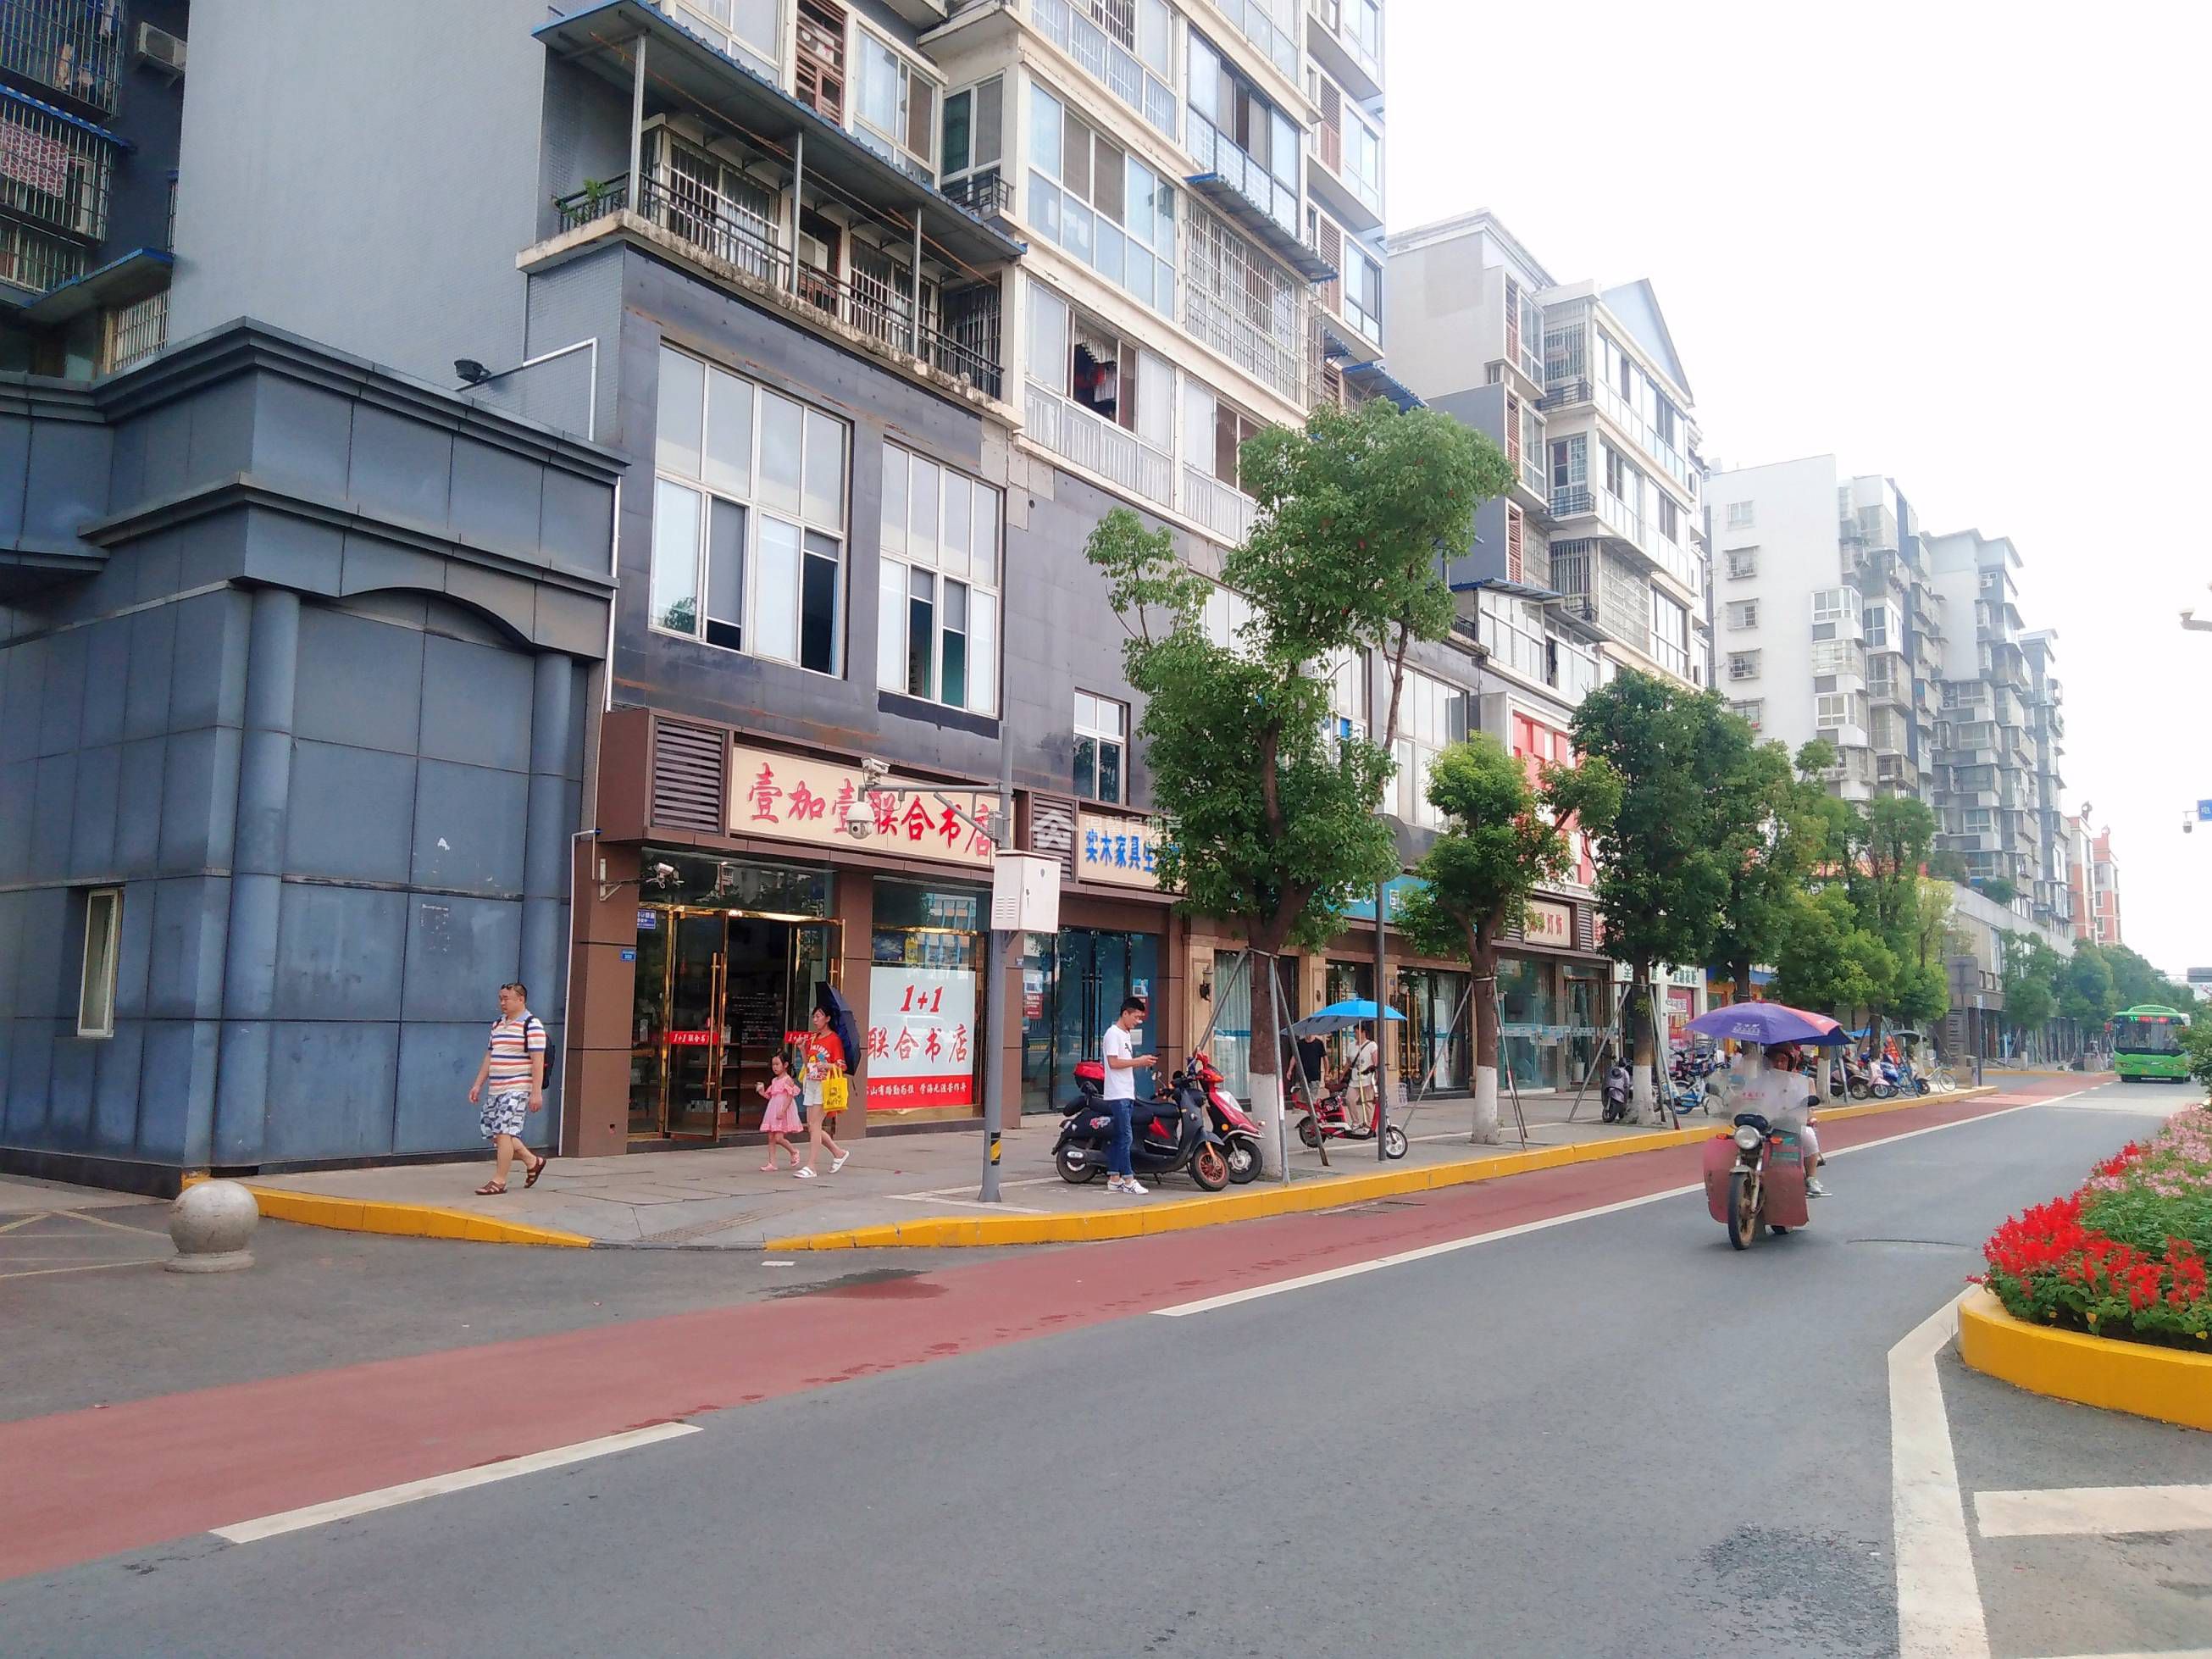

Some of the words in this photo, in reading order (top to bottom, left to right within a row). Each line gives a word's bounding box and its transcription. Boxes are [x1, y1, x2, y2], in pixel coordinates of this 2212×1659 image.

[748, 762, 991, 857] 壹加壹联合书店
[1085, 829, 1180, 874] 实木家具生
[900, 985, 944, 1013] 1+1
[868, 1023, 968, 1063] 联合书店
[867, 1084, 915, 1096] 山有路勤为径
